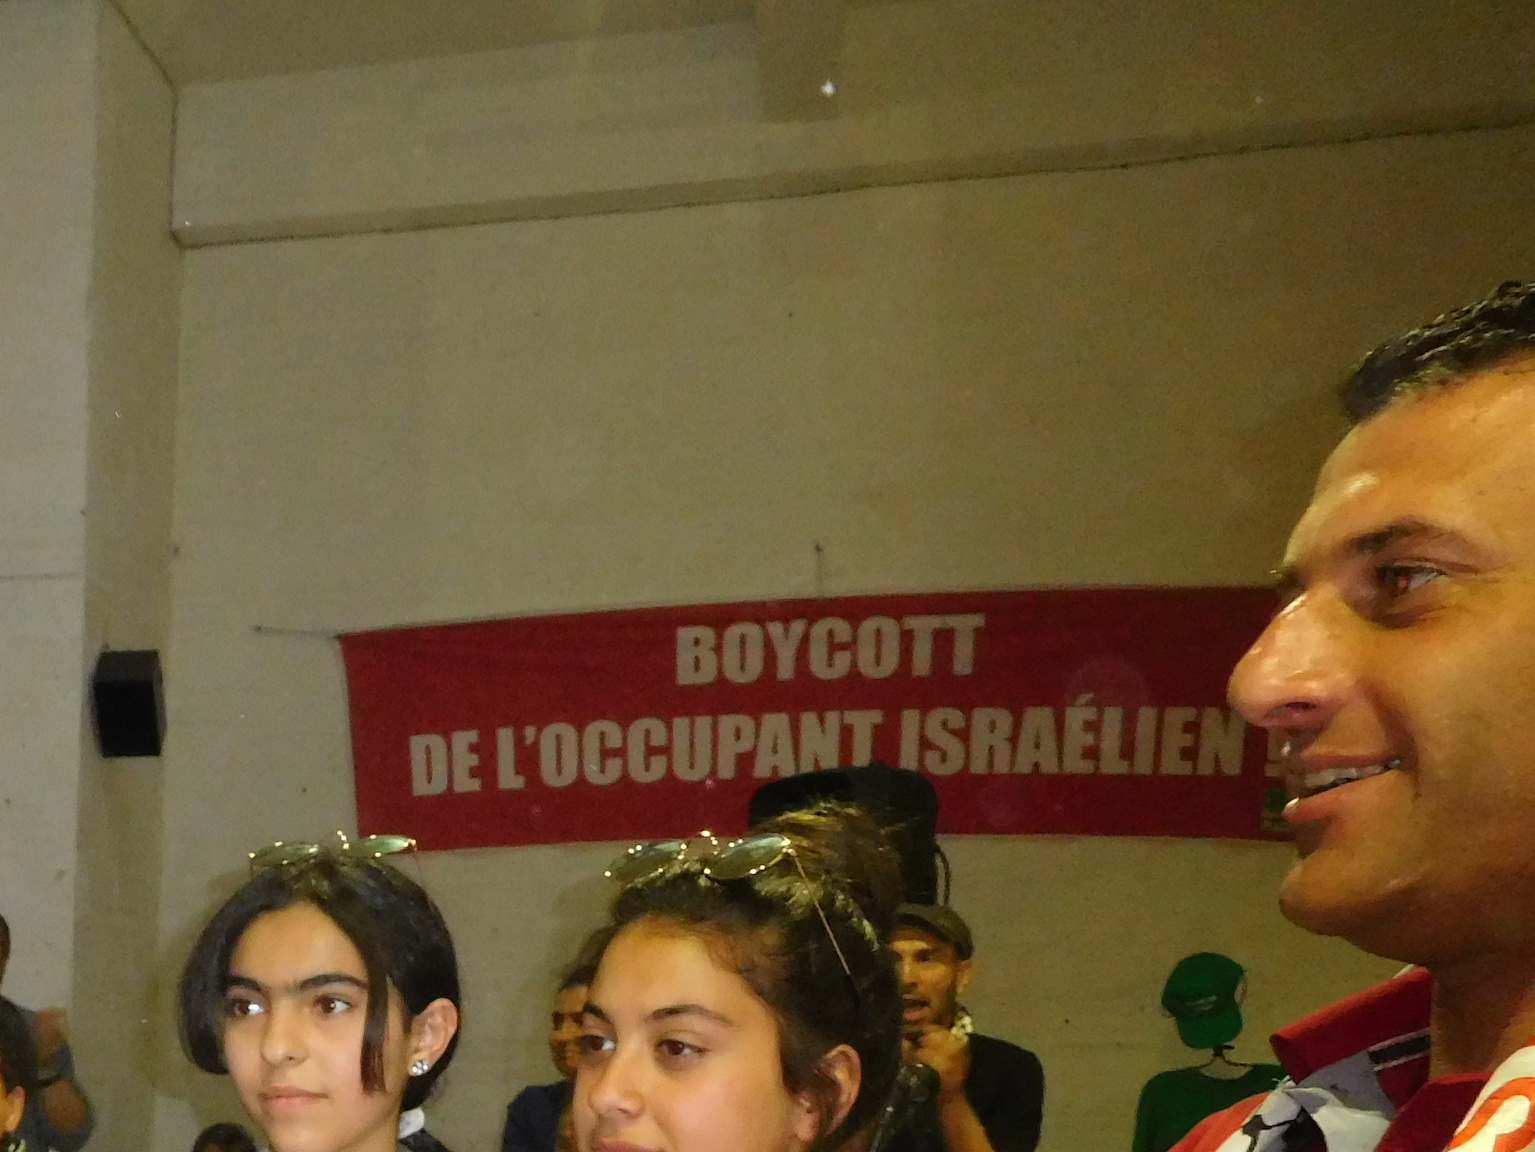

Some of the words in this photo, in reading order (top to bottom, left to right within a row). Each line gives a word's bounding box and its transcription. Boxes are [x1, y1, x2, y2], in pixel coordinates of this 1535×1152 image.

[675, 613, 987, 686] BOYCOTT
[409, 730, 482, 797] DE
[496, 709, 883, 791] L'OCCUPANT
[899, 695, 1246, 777] ISRAÉLIEN
